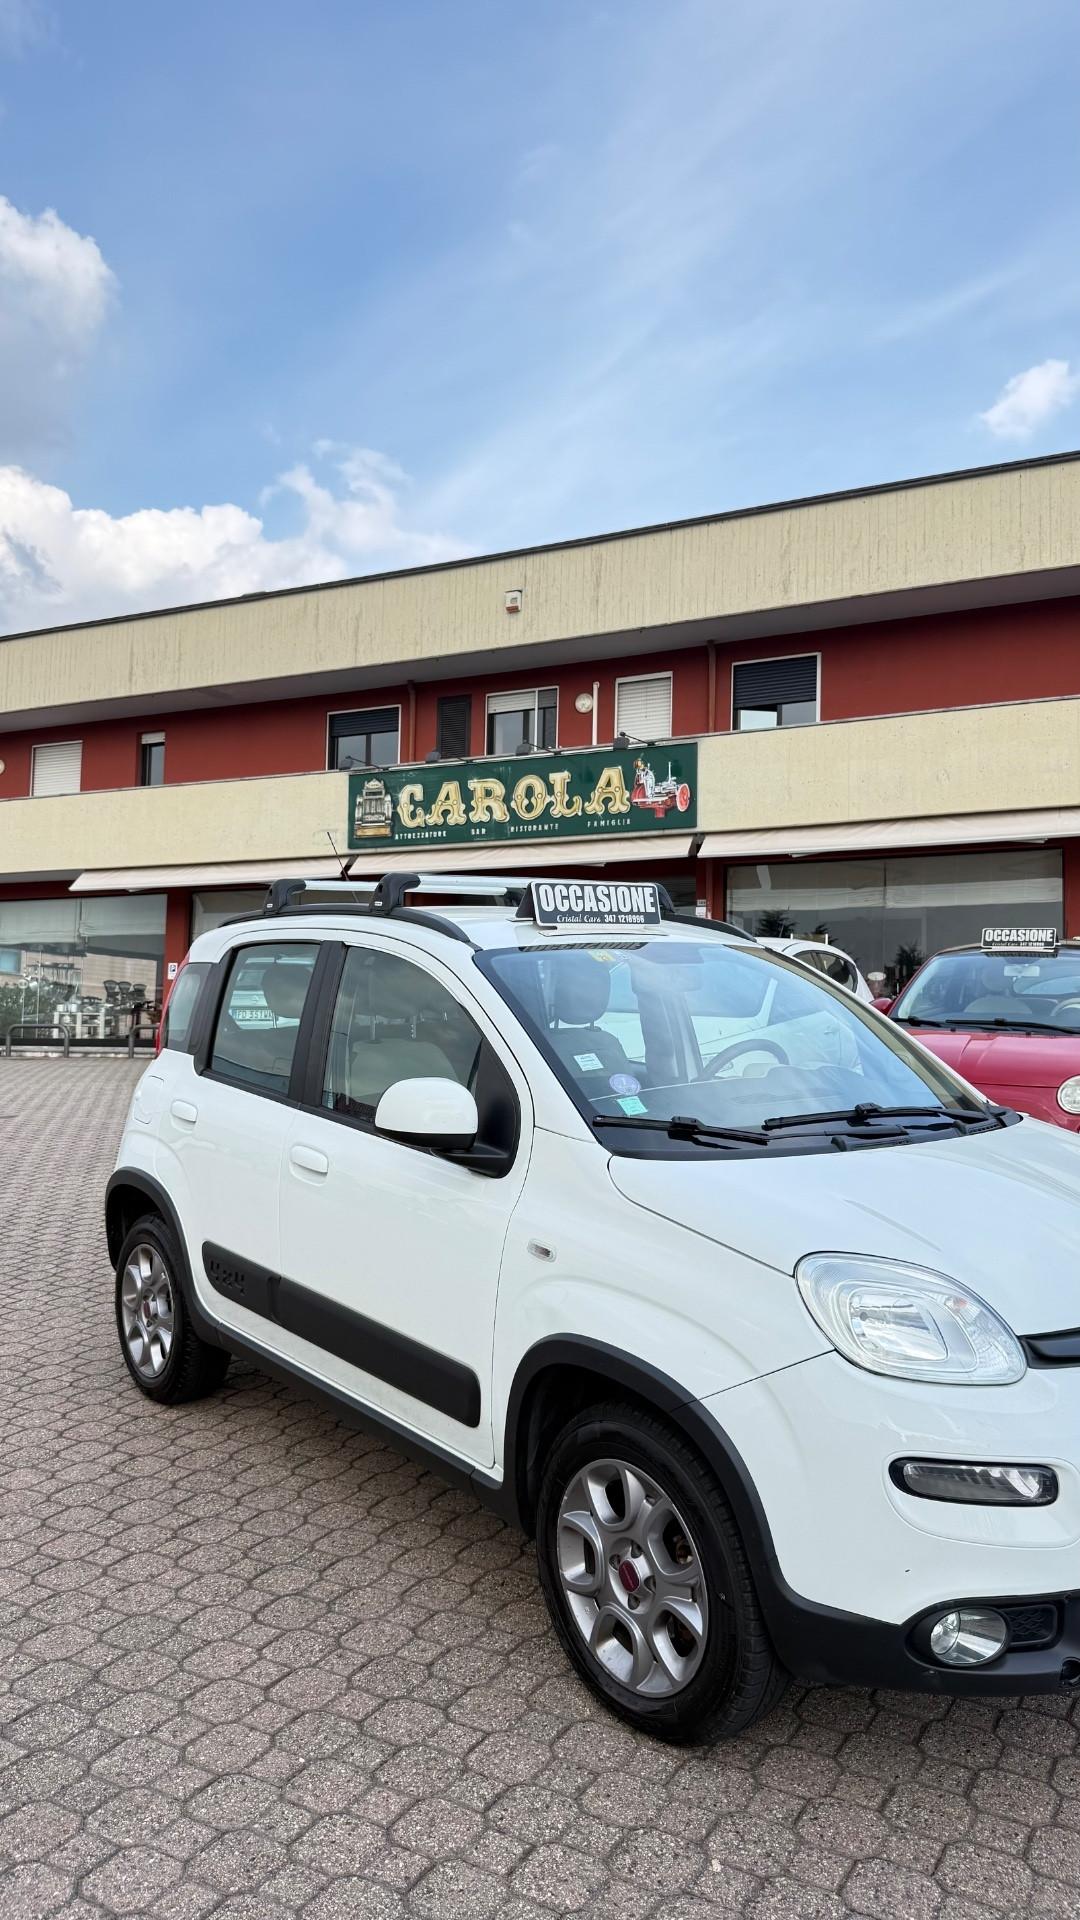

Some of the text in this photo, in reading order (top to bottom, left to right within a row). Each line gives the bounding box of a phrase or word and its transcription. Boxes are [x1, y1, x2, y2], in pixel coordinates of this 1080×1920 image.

[397, 766, 631, 829] CAROLA
[394, 830, 447, 840] ATTREZZATURE
[510, 823, 559, 832] RISTORANTE
[587, 818, 631, 828] FAMIGLIA
[538, 884, 656, 913] OCCASIONE
[556, 914, 582, 923] Cristal
[583, 914, 601, 923] Cars
[604, 914, 616, 923] 347
[985, 929, 1053, 942] OCCASIONE
